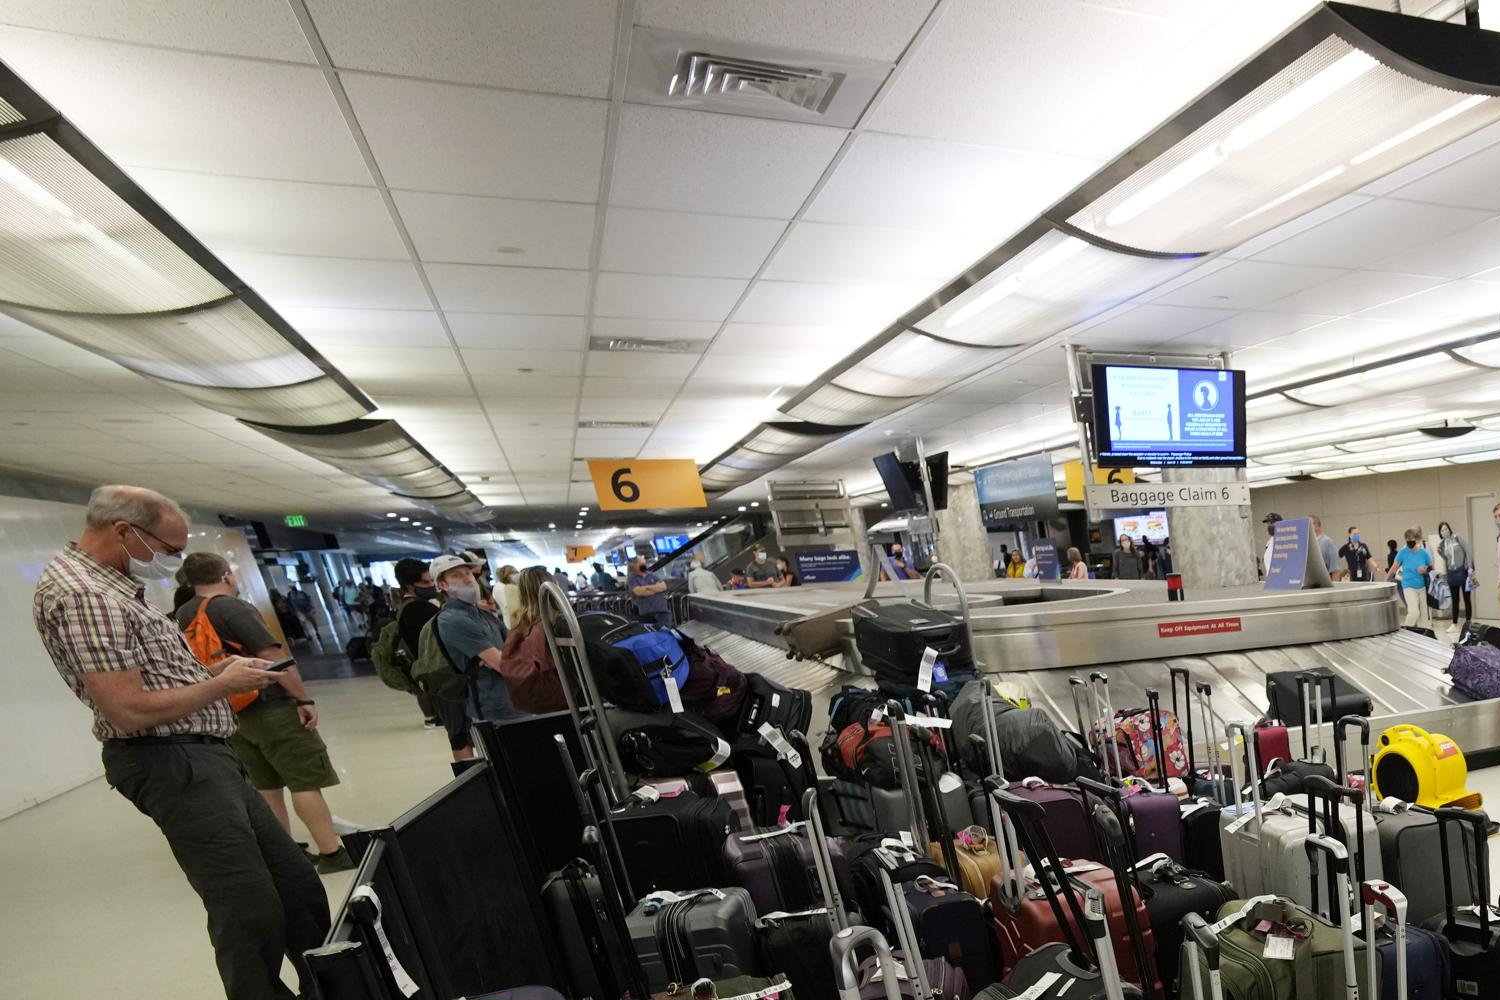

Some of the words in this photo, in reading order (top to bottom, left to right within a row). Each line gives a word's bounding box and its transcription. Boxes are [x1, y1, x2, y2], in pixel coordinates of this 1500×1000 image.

[611, 467, 640, 503] 6
[1110, 488, 1174, 505] Baggage
[1178, 487, 1217, 501] Claim
[1221, 487, 1230, 500] 6
[287, 515, 305, 527] EXIT
[1184, 624, 1209, 632] Equipment
